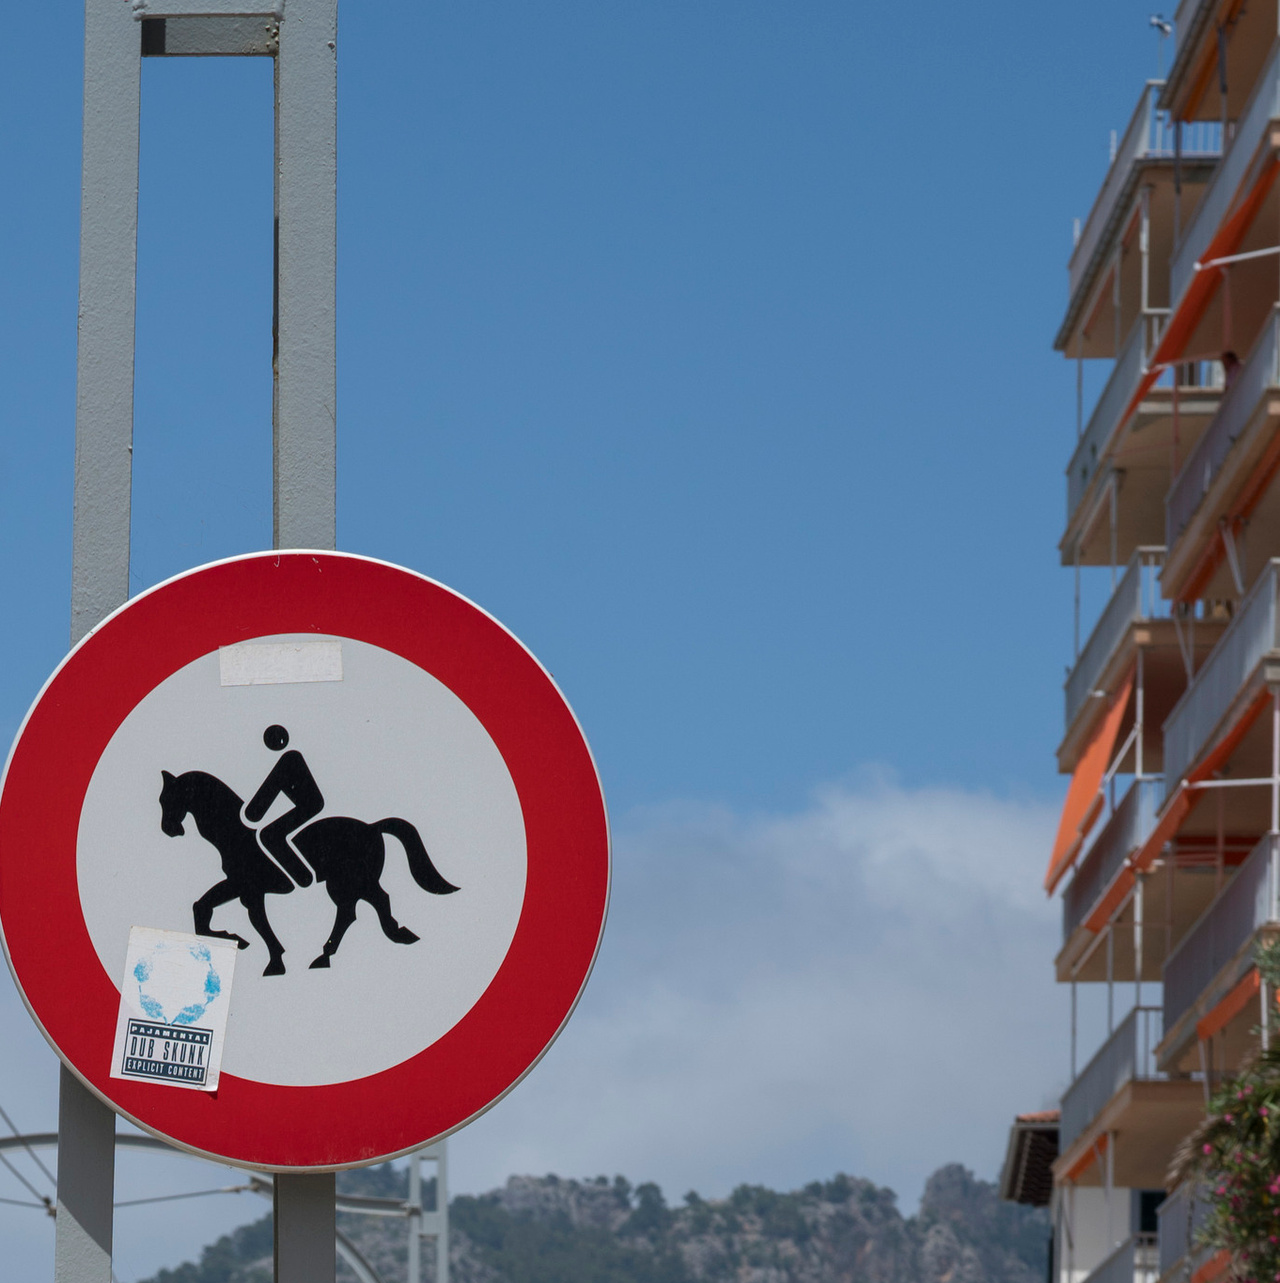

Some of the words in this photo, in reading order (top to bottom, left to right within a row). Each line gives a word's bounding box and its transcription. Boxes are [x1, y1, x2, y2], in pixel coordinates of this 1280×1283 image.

[131, 1026, 207, 1042] PAJAMENTAL
[130, 1037, 155, 1058] DUB
[163, 1041, 204, 1065] SKUNK
[127, 1059, 164, 1074] EXPLICIT
[167, 1065, 202, 1079] CONTENT
